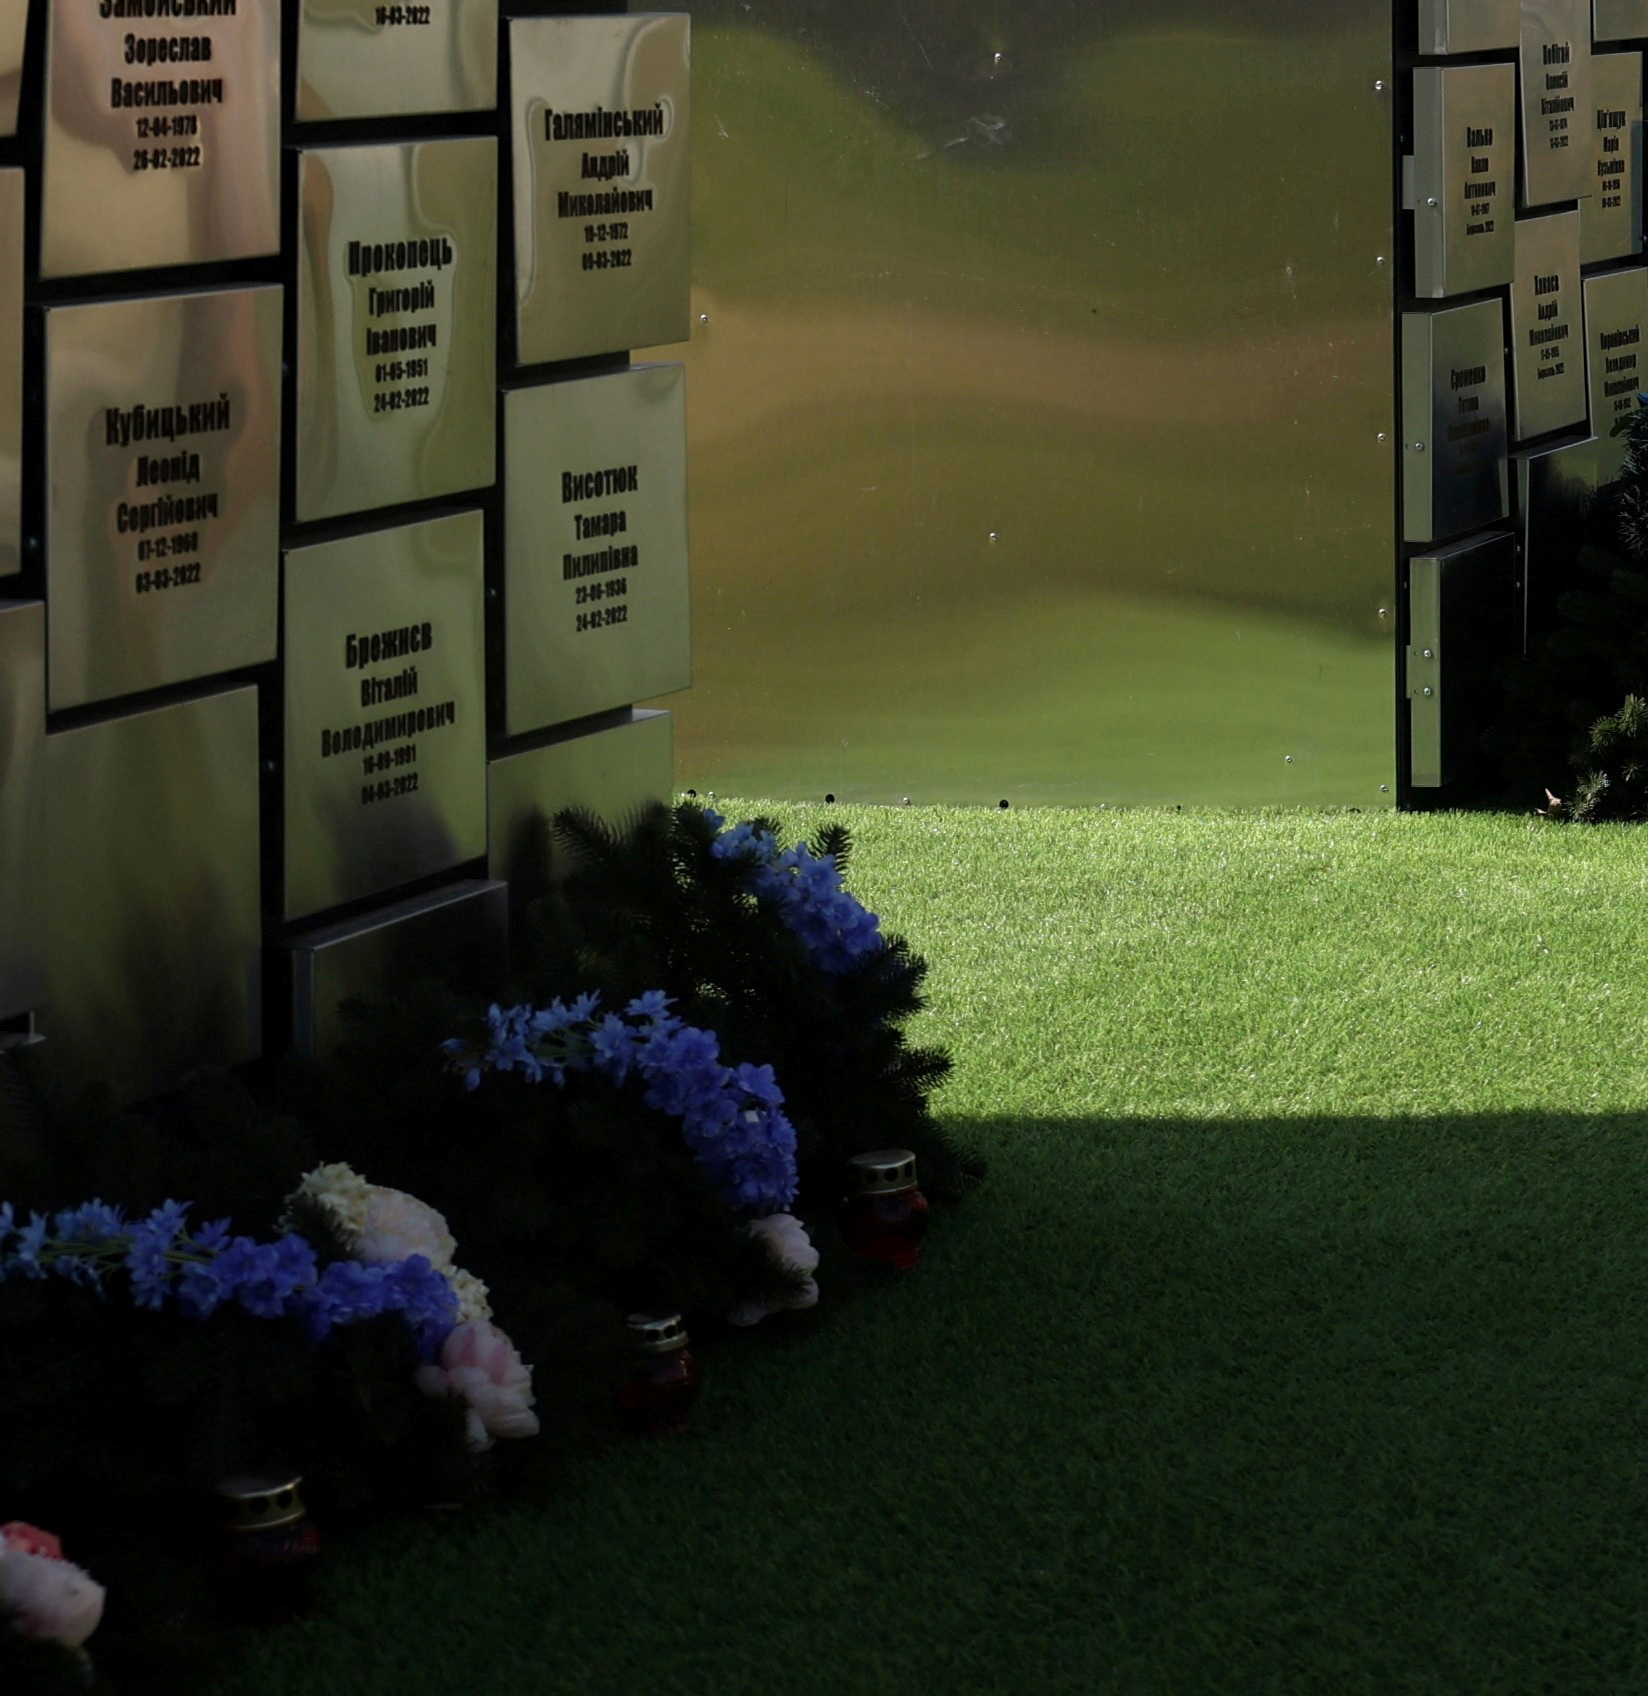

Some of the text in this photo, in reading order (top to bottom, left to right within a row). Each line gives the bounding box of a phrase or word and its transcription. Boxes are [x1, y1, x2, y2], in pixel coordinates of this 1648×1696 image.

[124, 33, 212, 66] Зореслав
[111, 78, 223, 108] Васильович
[544, 102, 663, 141] Галямінський
[582, 150, 629, 182] Андрій
[558, 186, 652, 218] Миколайович
[348, 238, 452, 278] Прокопець
[368, 280, 434, 318] Григорій
[366, 324, 436, 356] Іванович
[106, 392, 230, 448] Кубицький
[136, 450, 200, 487] Леонід
[562, 466, 638, 504] Висотюк
[117, 493, 218, 534] Сергійович
[574, 510, 626, 540] Тамара
[563, 545, 638, 580] Пилипівна
[346, 622, 432, 670] Брежнєв
[361, 666, 418, 707] Віталій
[322, 701, 454, 758] Володимирович
